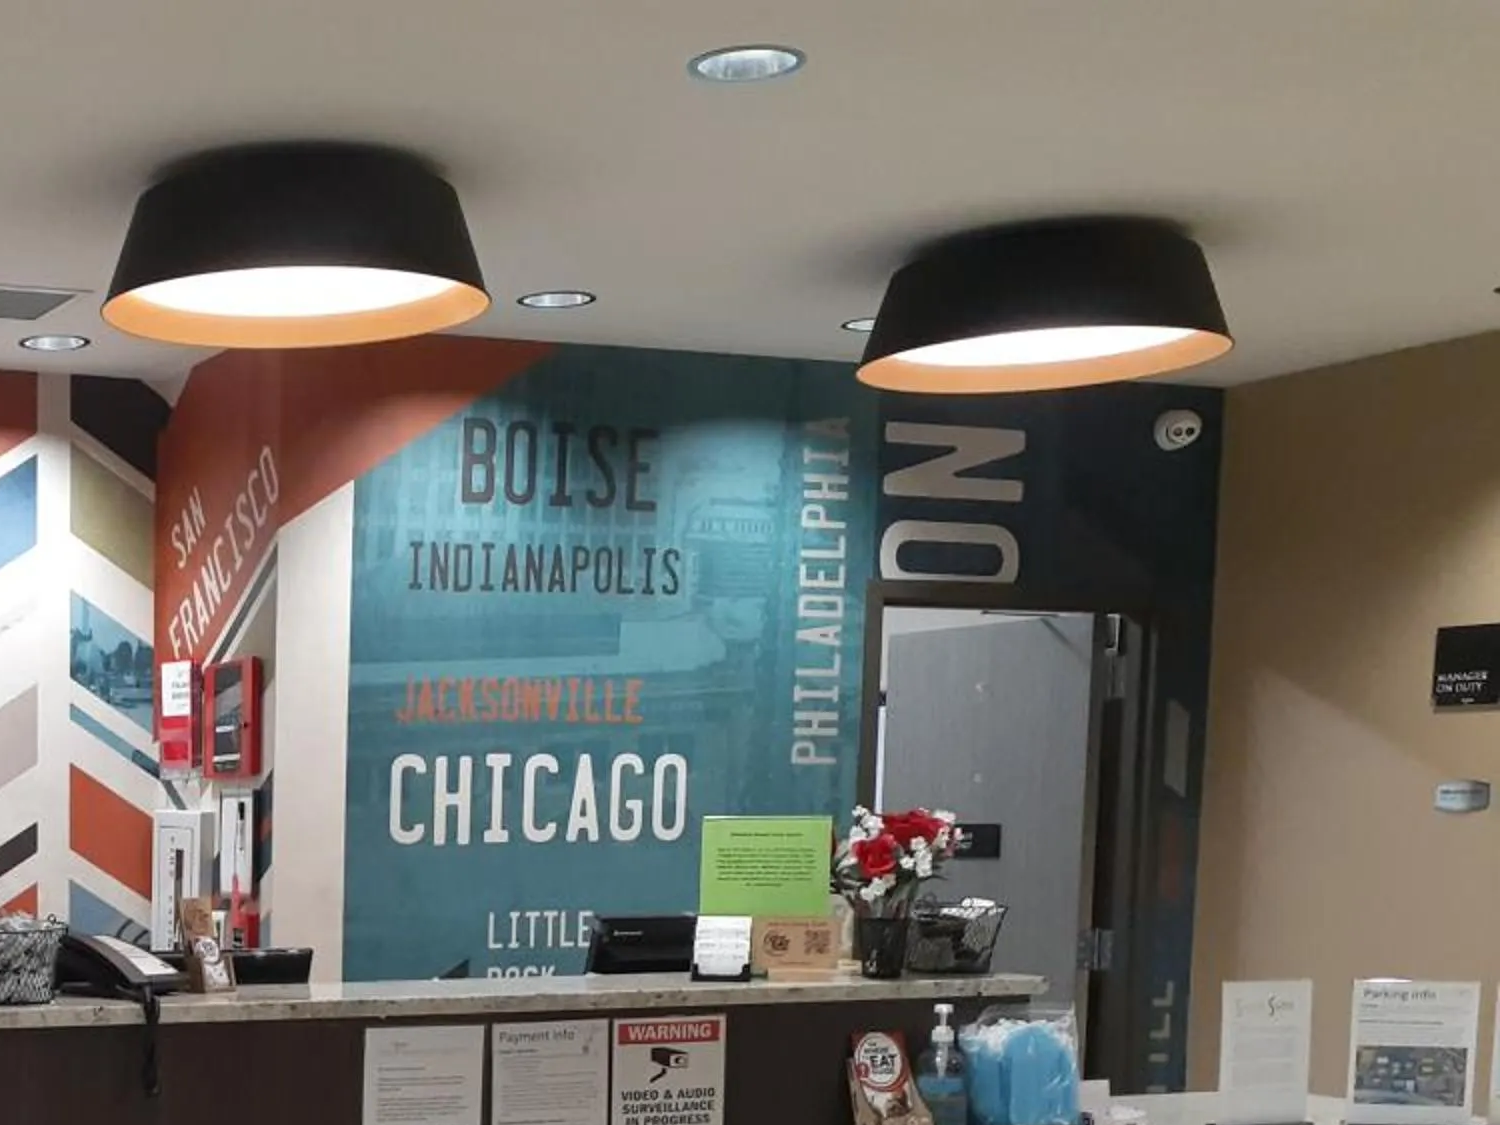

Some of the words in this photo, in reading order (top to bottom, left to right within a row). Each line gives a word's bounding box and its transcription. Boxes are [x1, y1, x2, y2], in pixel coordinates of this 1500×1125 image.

[461, 417, 660, 512] BOISE
[879, 420, 1027, 584] ON
[171, 485, 207, 570] SAN
[168, 445, 280, 661] FRANCISCO
[407, 540, 681, 596] INDIANAPOLIS
[790, 416, 851, 766] PHILADELPHIA
[1436, 683, 1453, 694] ON
[1455, 681, 1483, 693] DUTY
[1438, 669, 1488, 682] MANAGER
[394, 672, 645, 725] JACKSONVILLE
[388, 752, 688, 847] CHICAGO
[487, 910, 594, 949] LITTLE
[1363, 988, 1410, 1002] Parking
[1411, 988, 1437, 1000] info
[499, 1030, 550, 1046] Payment
[627, 1022, 712, 1041] WARNING
[870, 1054, 897, 1068] EAT
[621, 1089, 659, 1101] VIDEO
[663, 1088, 673, 1100] &
[677, 1087, 716, 1099] AUDIO
[621, 1099, 715, 1115] SURVEILLANCE
[643, 1113, 711, 1125] PROGRESS
